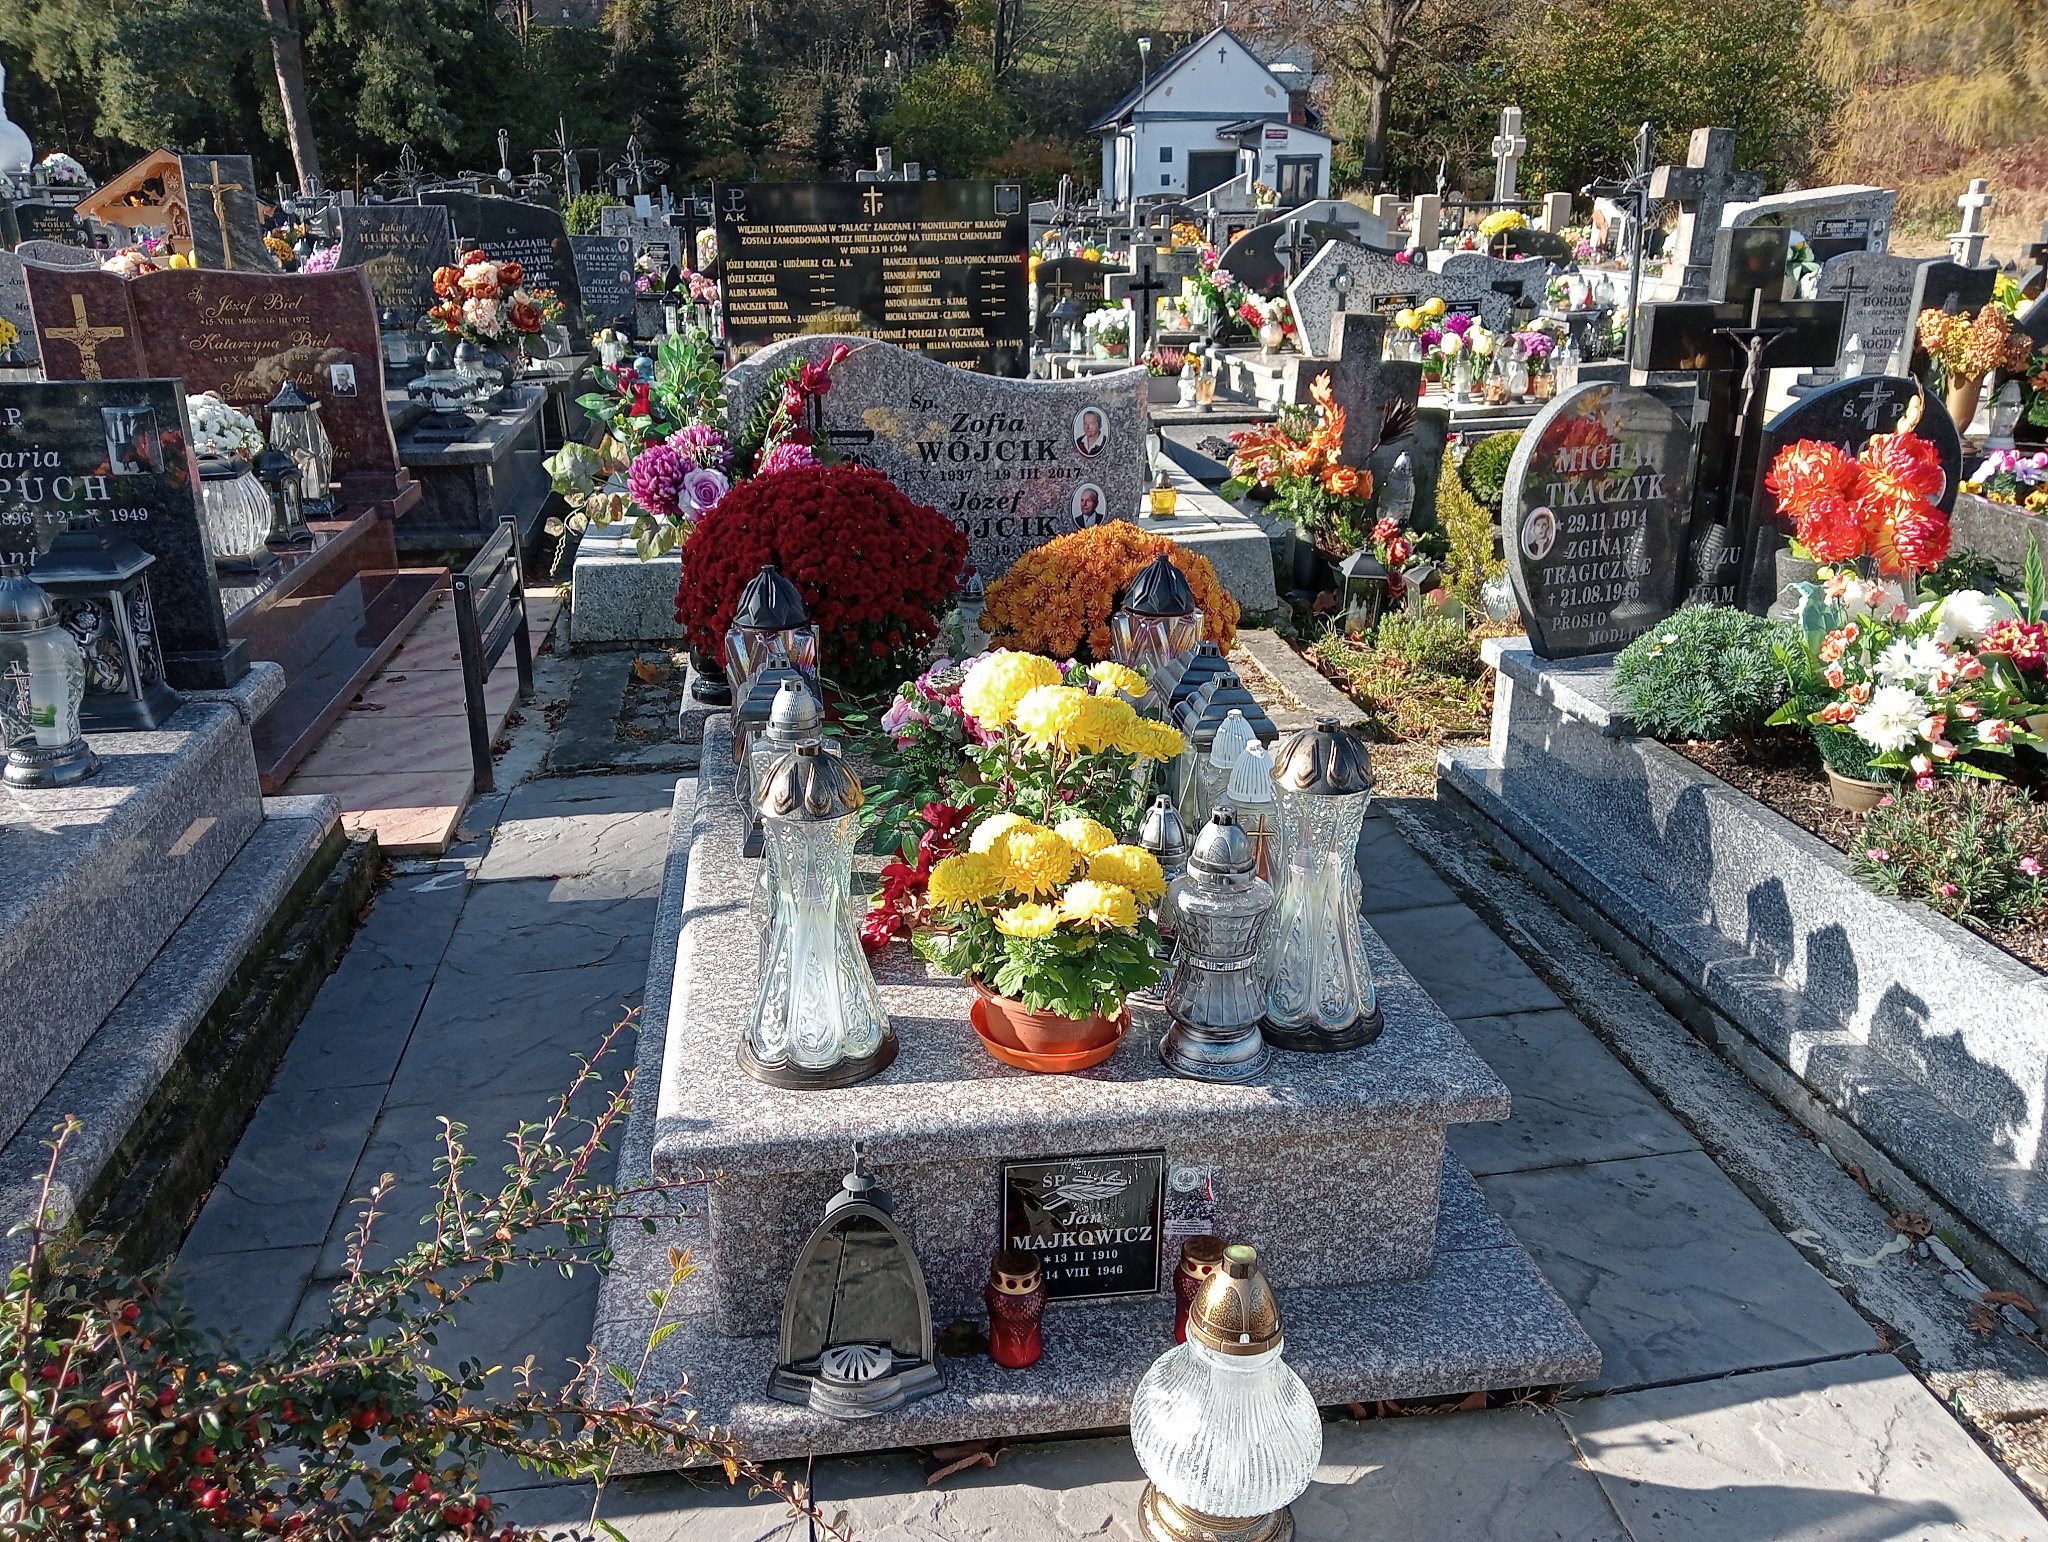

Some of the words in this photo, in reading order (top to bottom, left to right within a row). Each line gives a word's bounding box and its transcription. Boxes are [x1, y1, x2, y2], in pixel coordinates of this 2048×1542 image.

[724, 213, 748, 222] A.K.
[737, 225, 769, 235] WIĘZIENI
[828, 224, 837, 232] W
[873, 222, 912, 231] ZAKOPANE
[974, 219, 1008, 228] KRAKÓW
[741, 236, 771, 245] ZOSTALI
[772, 236, 830, 245] ZAMORDOWANI
[831, 235, 853, 244] PRZEZ
[854, 233, 908, 243] HITLEROWCÓW
[908, 233, 920, 241] NA
[921, 232, 958, 242] TUTEJSZYM
[959, 231, 1002, 240] CMENTARZU
[840, 246, 849, 254] W
[850, 246, 869, 254] DNIU
[871, 245, 880, 253] 23
[890, 245, 908, 253] 1944
[726, 259, 744, 271] JÓZEF
[883, 257, 918, 266] FRANCISZEK
[727, 273, 745, 284] JÓZEF
[728, 288, 748, 297] ALBIN
[205, 295, 256, 318] Józef
[263, 293, 303, 311] Biel
[729, 302, 767, 312] FRANCISZEK
[767, 301, 789, 311] TURZA
[884, 298, 908, 308] ANTONI
[730, 315, 768, 325] WŁADYSŁAW
[768, 315, 792, 324] STOPKA
[872, 327, 907, 339] RÓWNIEŻ
[907, 329, 936, 339] POLEGLI
[937, 328, 948, 338] ZA
[189, 333, 280, 354] Katarzyna
[291, 331, 331, 348] Biel
[950, 412, 1025, 437] Zofia
[0, 444, 62, 468] aria
[916, 434, 1060, 463] WÓJCIK
[1557, 441, 1660, 474] MICHAŁ
[917, 470, 931, 481] V
[940, 470, 973, 481] 1937
[995, 469, 1011, 480] 19
[1020, 469, 1039, 479] III
[1049, 467, 1081, 479] 2017
[1546, 473, 1668, 509] TKACZYK
[950, 489, 1025, 514] Józef
[0, 510, 33, 527] 896
[110, 507, 149, 523] 1949
[1566, 508, 1648, 535] 29.11.1914
[953, 514, 1059, 539] ÓJCIK
[1542, 557, 1652, 587] TRAGICZNIE
[1560, 579, 1641, 608] 21.08.1946
[1551, 612, 1595, 632] PROSI
[1597, 611, 1607, 626] O
[1042, 1173, 1066, 1189] ŚP
[1062, 1210, 1102, 1227] Jan
[1012, 1226, 1152, 1252] MAJKOWICZ
[1054, 1252, 1067, 1264] 13
[1075, 1252, 1085, 1262] II
[1092, 1249, 1118, 1261] 1910
[1066, 1267, 1090, 1279] VIII
[1097, 1264, 1123, 1276] 1946
